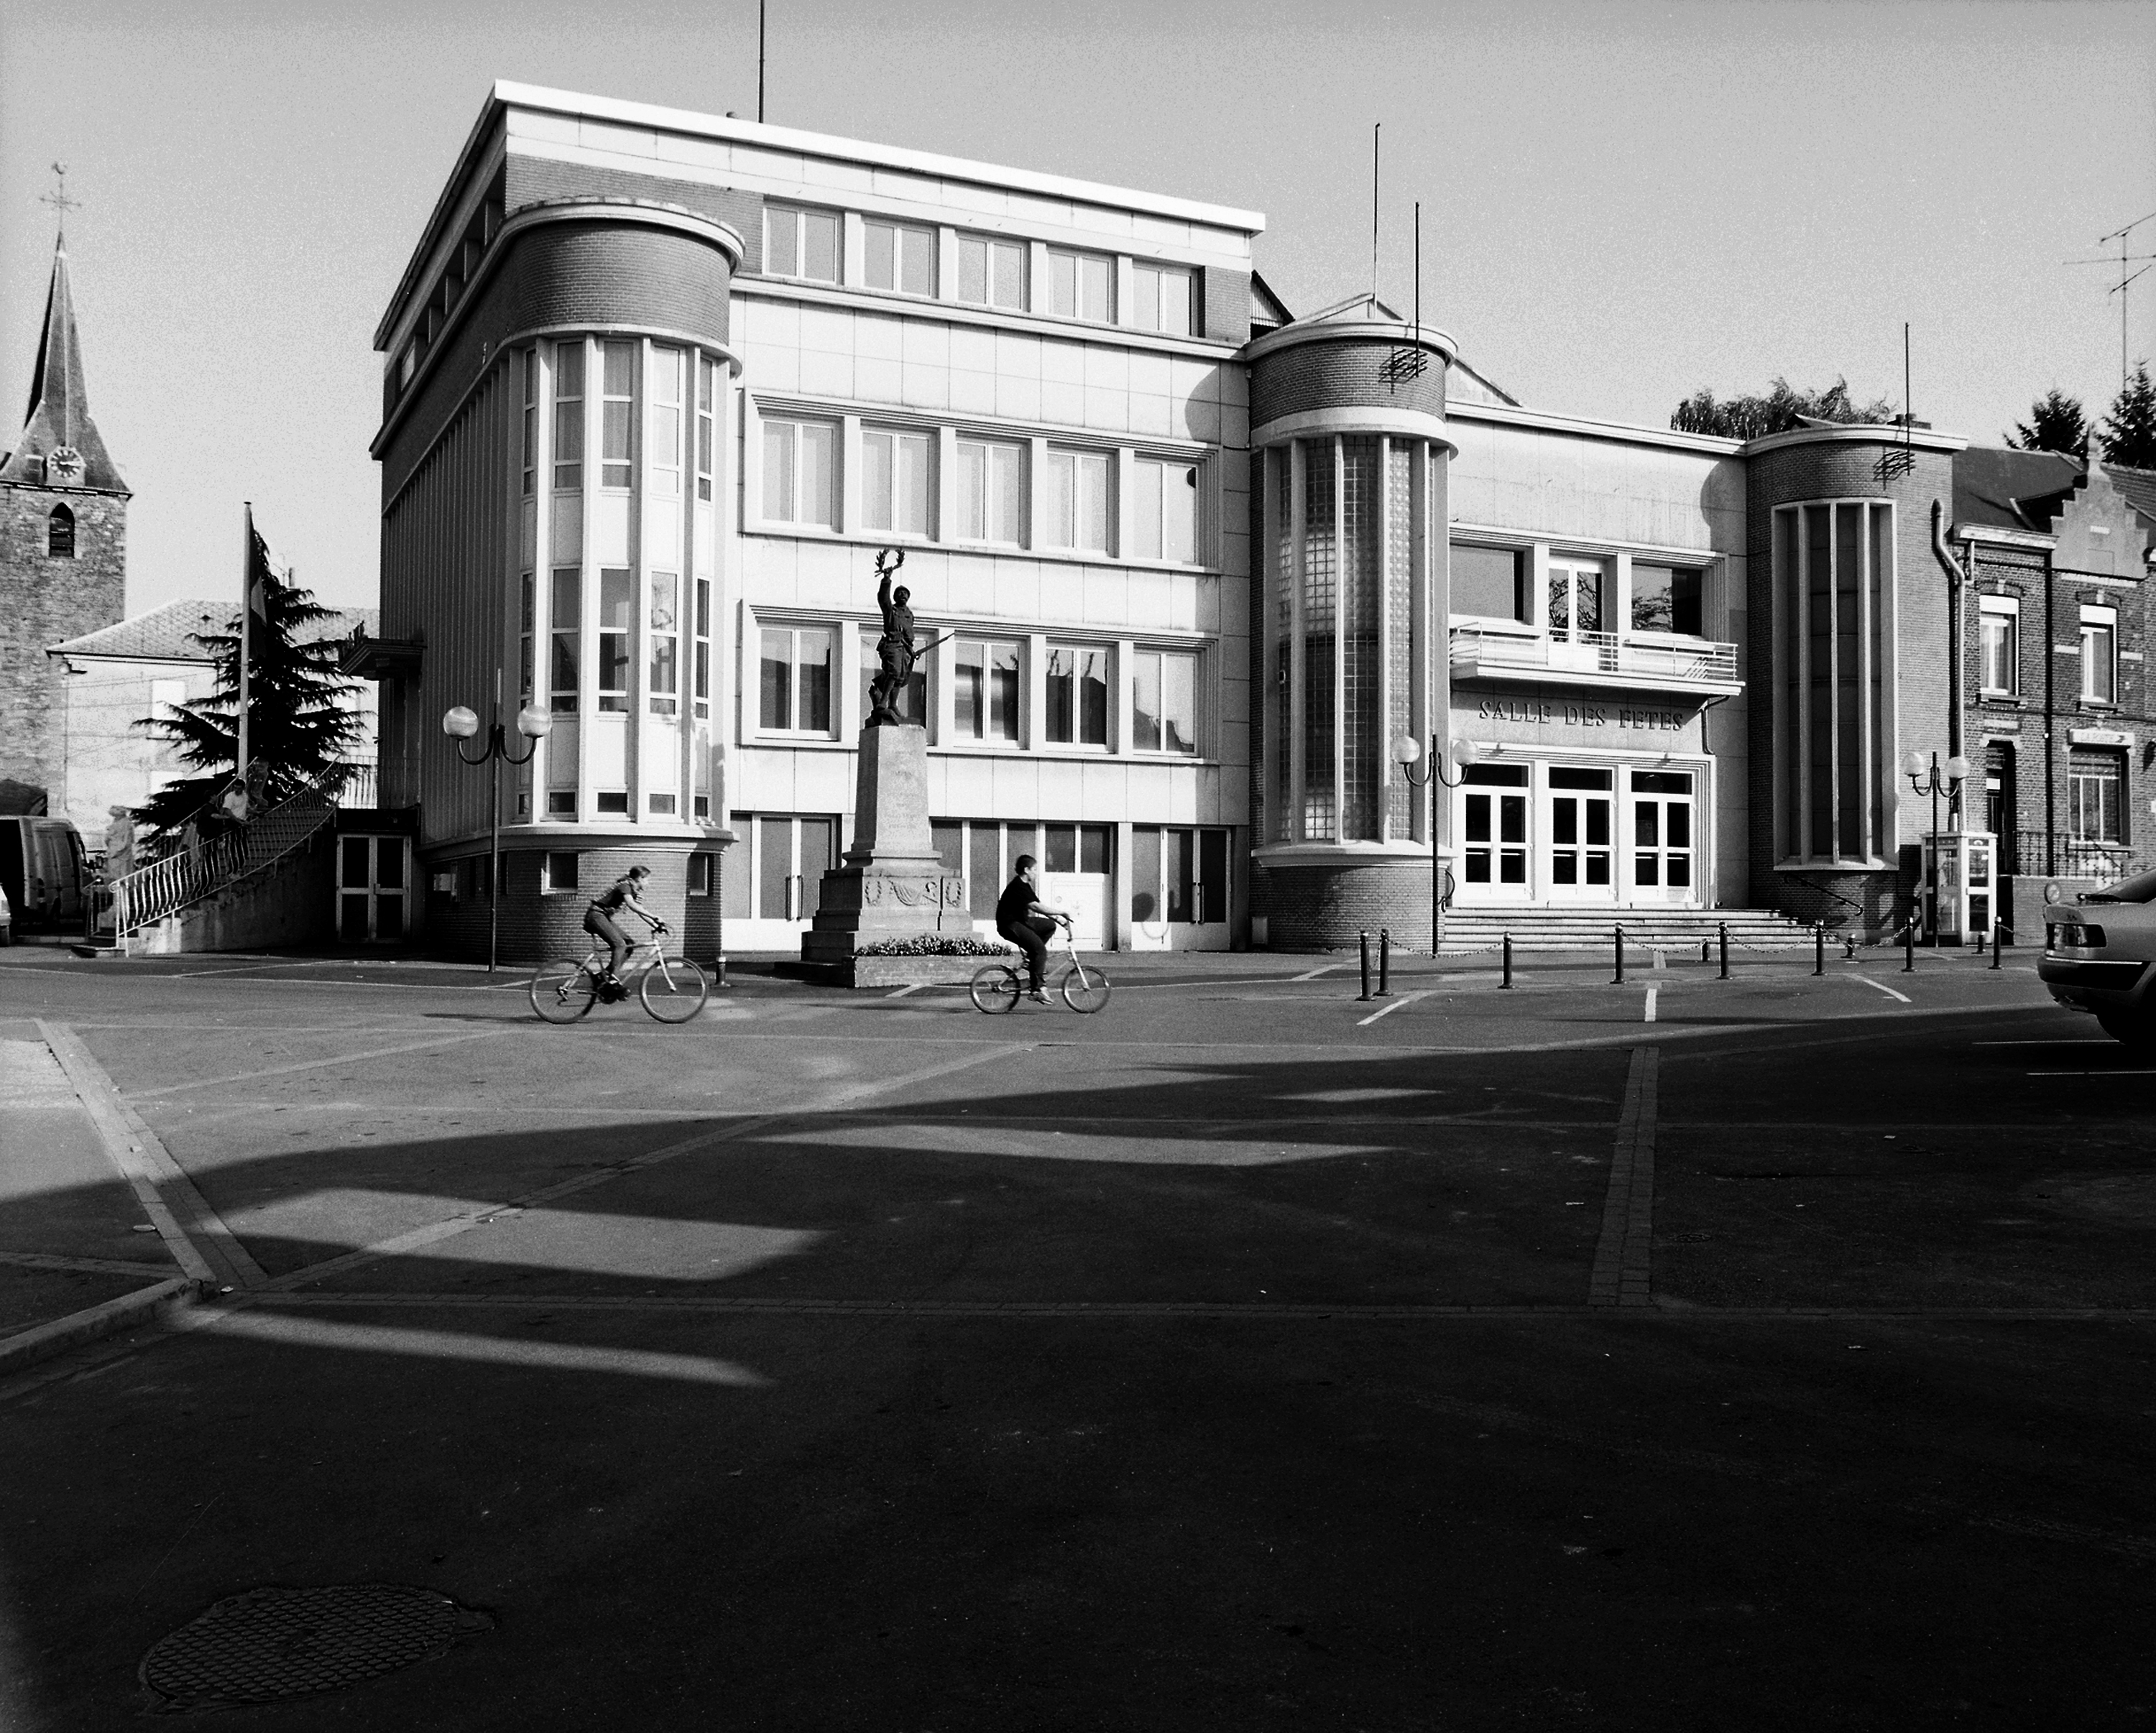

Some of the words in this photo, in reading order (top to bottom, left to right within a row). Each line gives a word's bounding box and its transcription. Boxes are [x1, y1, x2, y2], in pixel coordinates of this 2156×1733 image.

[1479, 701, 1551, 724] SALLE
[1565, 706, 1606, 726] DES
[1619, 709, 1682, 731] FETES
